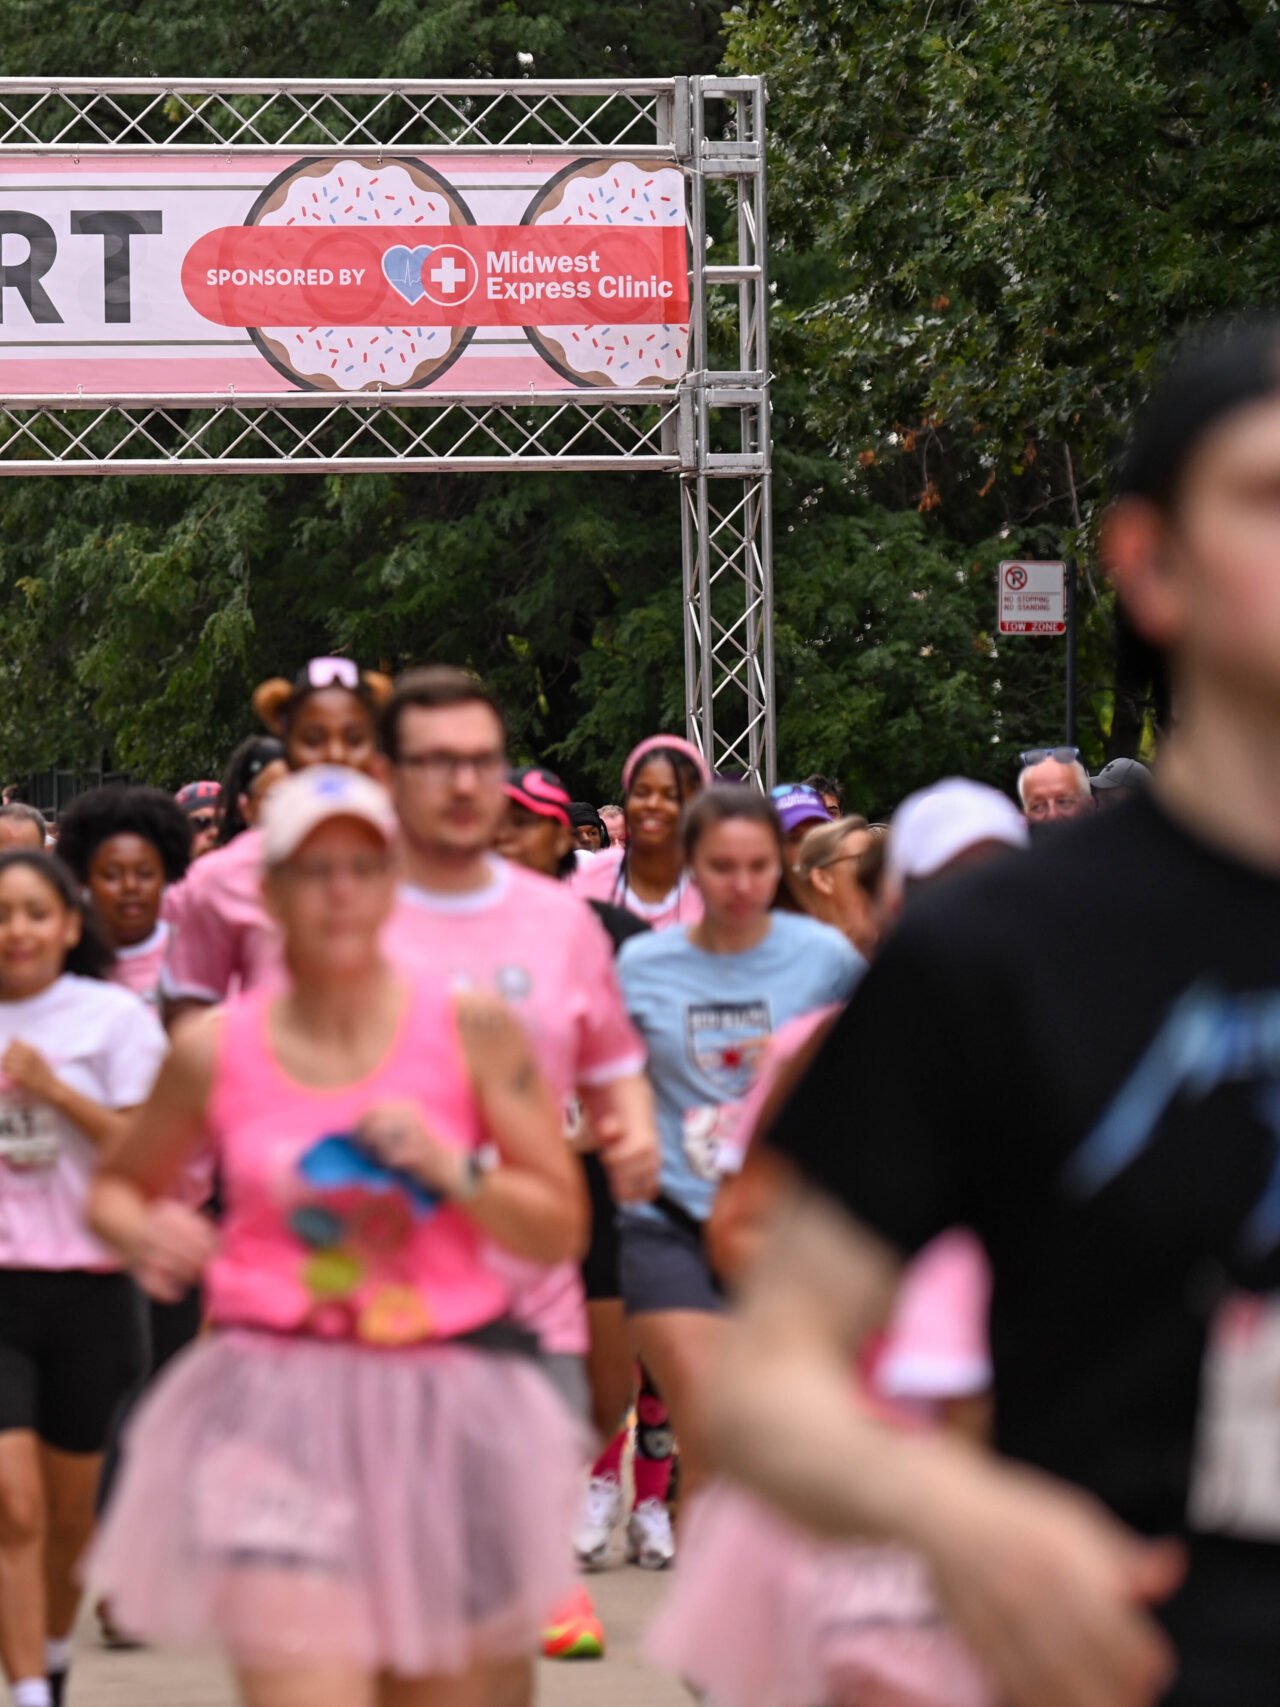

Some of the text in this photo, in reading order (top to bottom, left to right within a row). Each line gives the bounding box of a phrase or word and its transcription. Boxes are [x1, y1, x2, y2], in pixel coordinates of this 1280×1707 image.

[487, 251, 600, 273] Midwest
[206, 269, 365, 286] SPONSORED BY
[487, 275, 673, 304] Express Clinic
[1005, 622, 1056, 631] TOW ZONE
